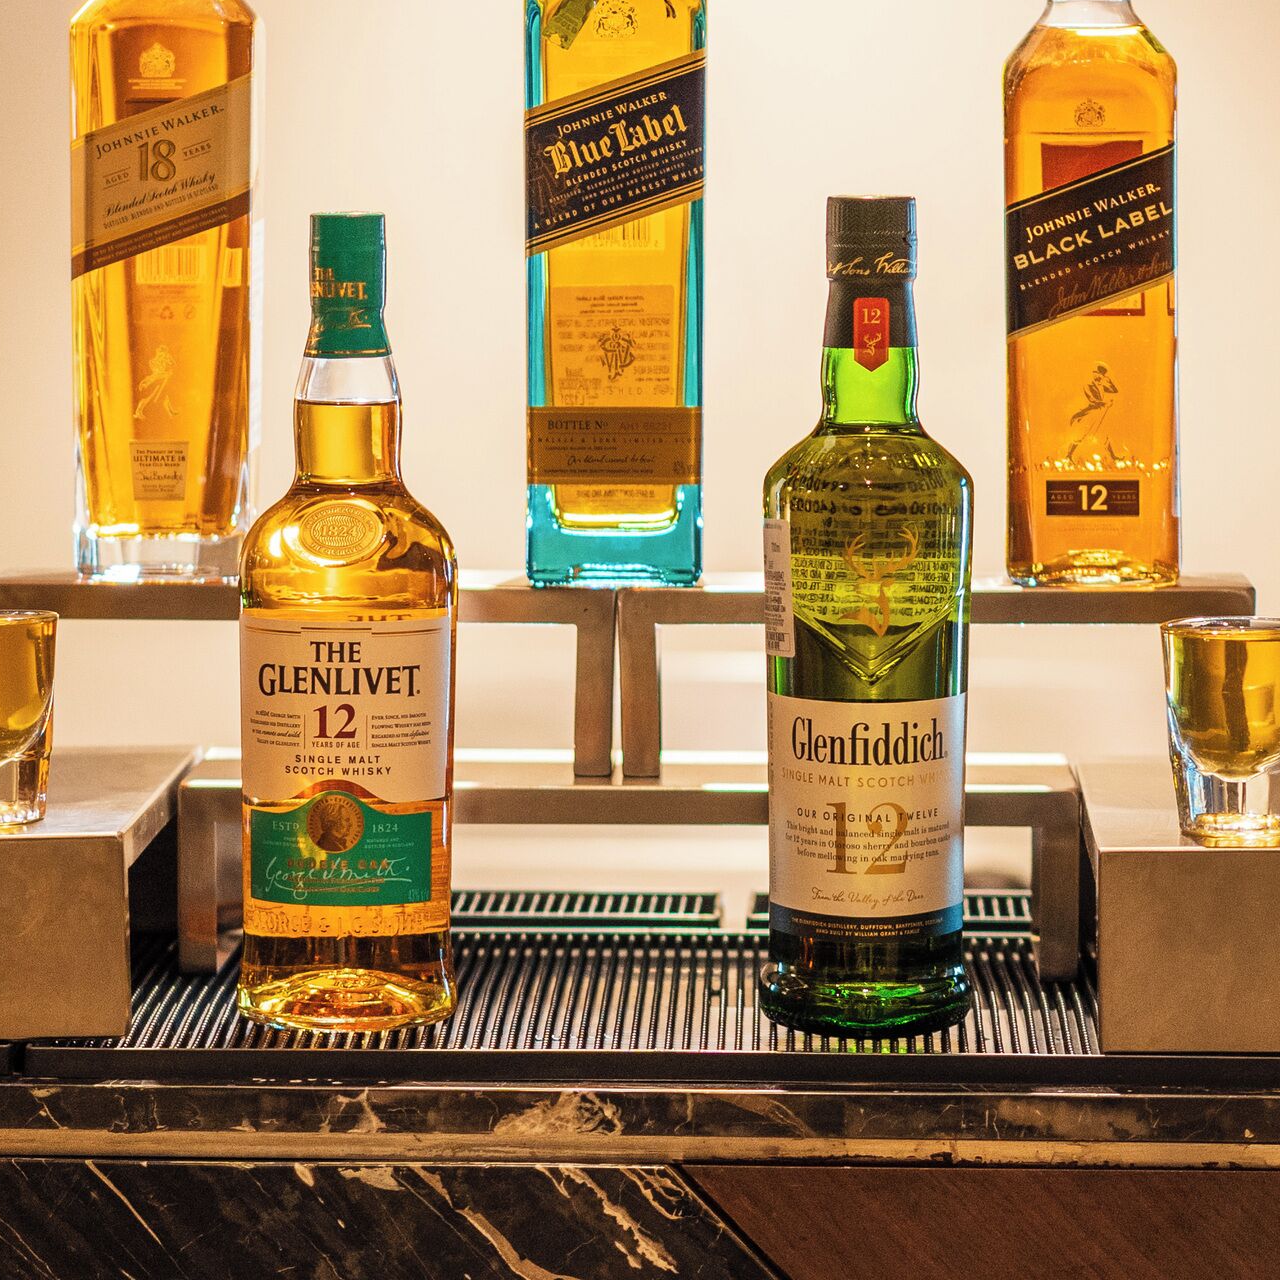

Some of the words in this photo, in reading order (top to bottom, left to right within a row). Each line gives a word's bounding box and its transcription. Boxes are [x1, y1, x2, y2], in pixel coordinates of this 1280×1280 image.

[557, 109, 614, 138] JOHNNIE
[615, 91, 668, 116] WALKER
[96, 127, 160, 160] JOHNNIE
[161, 104, 221, 132] WALKER
[543, 136, 613, 179] Blue
[608, 104, 688, 156] Label
[138, 139, 176, 182] 18
[183, 142, 212, 158] YEARS
[566, 167, 608, 187] BLENDED
[612, 154, 648, 171] SCOTCH
[651, 139, 688, 158] WHISKY
[104, 172, 129, 186] AGED
[104, 193, 146, 218] Blended
[180, 173, 216, 191] Whisky
[534, 222, 540, 230] A
[545, 209, 578, 226] BLEND
[583, 200, 596, 213] OF
[601, 195, 623, 207] OUR
[628, 178, 667, 197] RAREST
[1025, 206, 1093, 244] JOHNNIE
[1094, 182, 1158, 213] WALKER
[1013, 229, 1093, 270] BLACK
[1098, 201, 1173, 239] LABEL
[1020, 267, 1072, 291] BLENDED
[1078, 248, 1122, 269] SCOTCH
[1128, 230, 1171, 250] WHISKY
[862, 308, 881, 324] 12
[548, 419, 591, 430] BOTTLE
[1078, 484, 1108, 511] 12
[322, 525, 358, 537] 1824
[310, 641, 362, 663] THE
[313, 703, 358, 739] 12
[311, 741, 334, 749] YEARS
[336, 741, 345, 749] OF
[347, 741, 360, 749] AGE
[792, 716, 945, 766] Glenfiddich
[295, 754, 341, 764] SINGLE
[349, 755, 381, 764] MALT
[285, 765, 334, 776] SCOTCH
[341, 766, 392, 775] WHISKY
[782, 767, 813, 784] SINGLE
[818, 775, 850, 787] MALT
[857, 775, 914, 788] SCOTCH
[797, 807, 817, 819] OUR
[823, 811, 891, 822] ORIGINAL
[898, 808, 938, 821] TWELVE
[372, 823, 399, 833] 1824
[786, 820, 797, 830] This
[799, 822, 818, 834] bright
[820, 827, 833, 836] and
[836, 829, 875, 838] balanced
[877, 830, 903, 839] single
[904, 827, 919, 836] malt
[921, 826, 927, 834] is
[826, 801, 908, 875] 12
[794, 834, 800, 843] 12
[800, 838, 818, 847] years
[819, 839, 826, 847] in
[828, 839, 861, 849] Oloroso
[863, 842, 892, 852] sherry
[894, 840, 909, 849] and
[911, 836, 937, 848] bourbon
[797, 847, 816, 858] before
[817, 851, 858, 864] mellowing
[860, 853, 869, 862] in
[871, 852, 888, 862] oak
[890, 851, 924, 862] marrying
[832, 890, 845, 902] the
